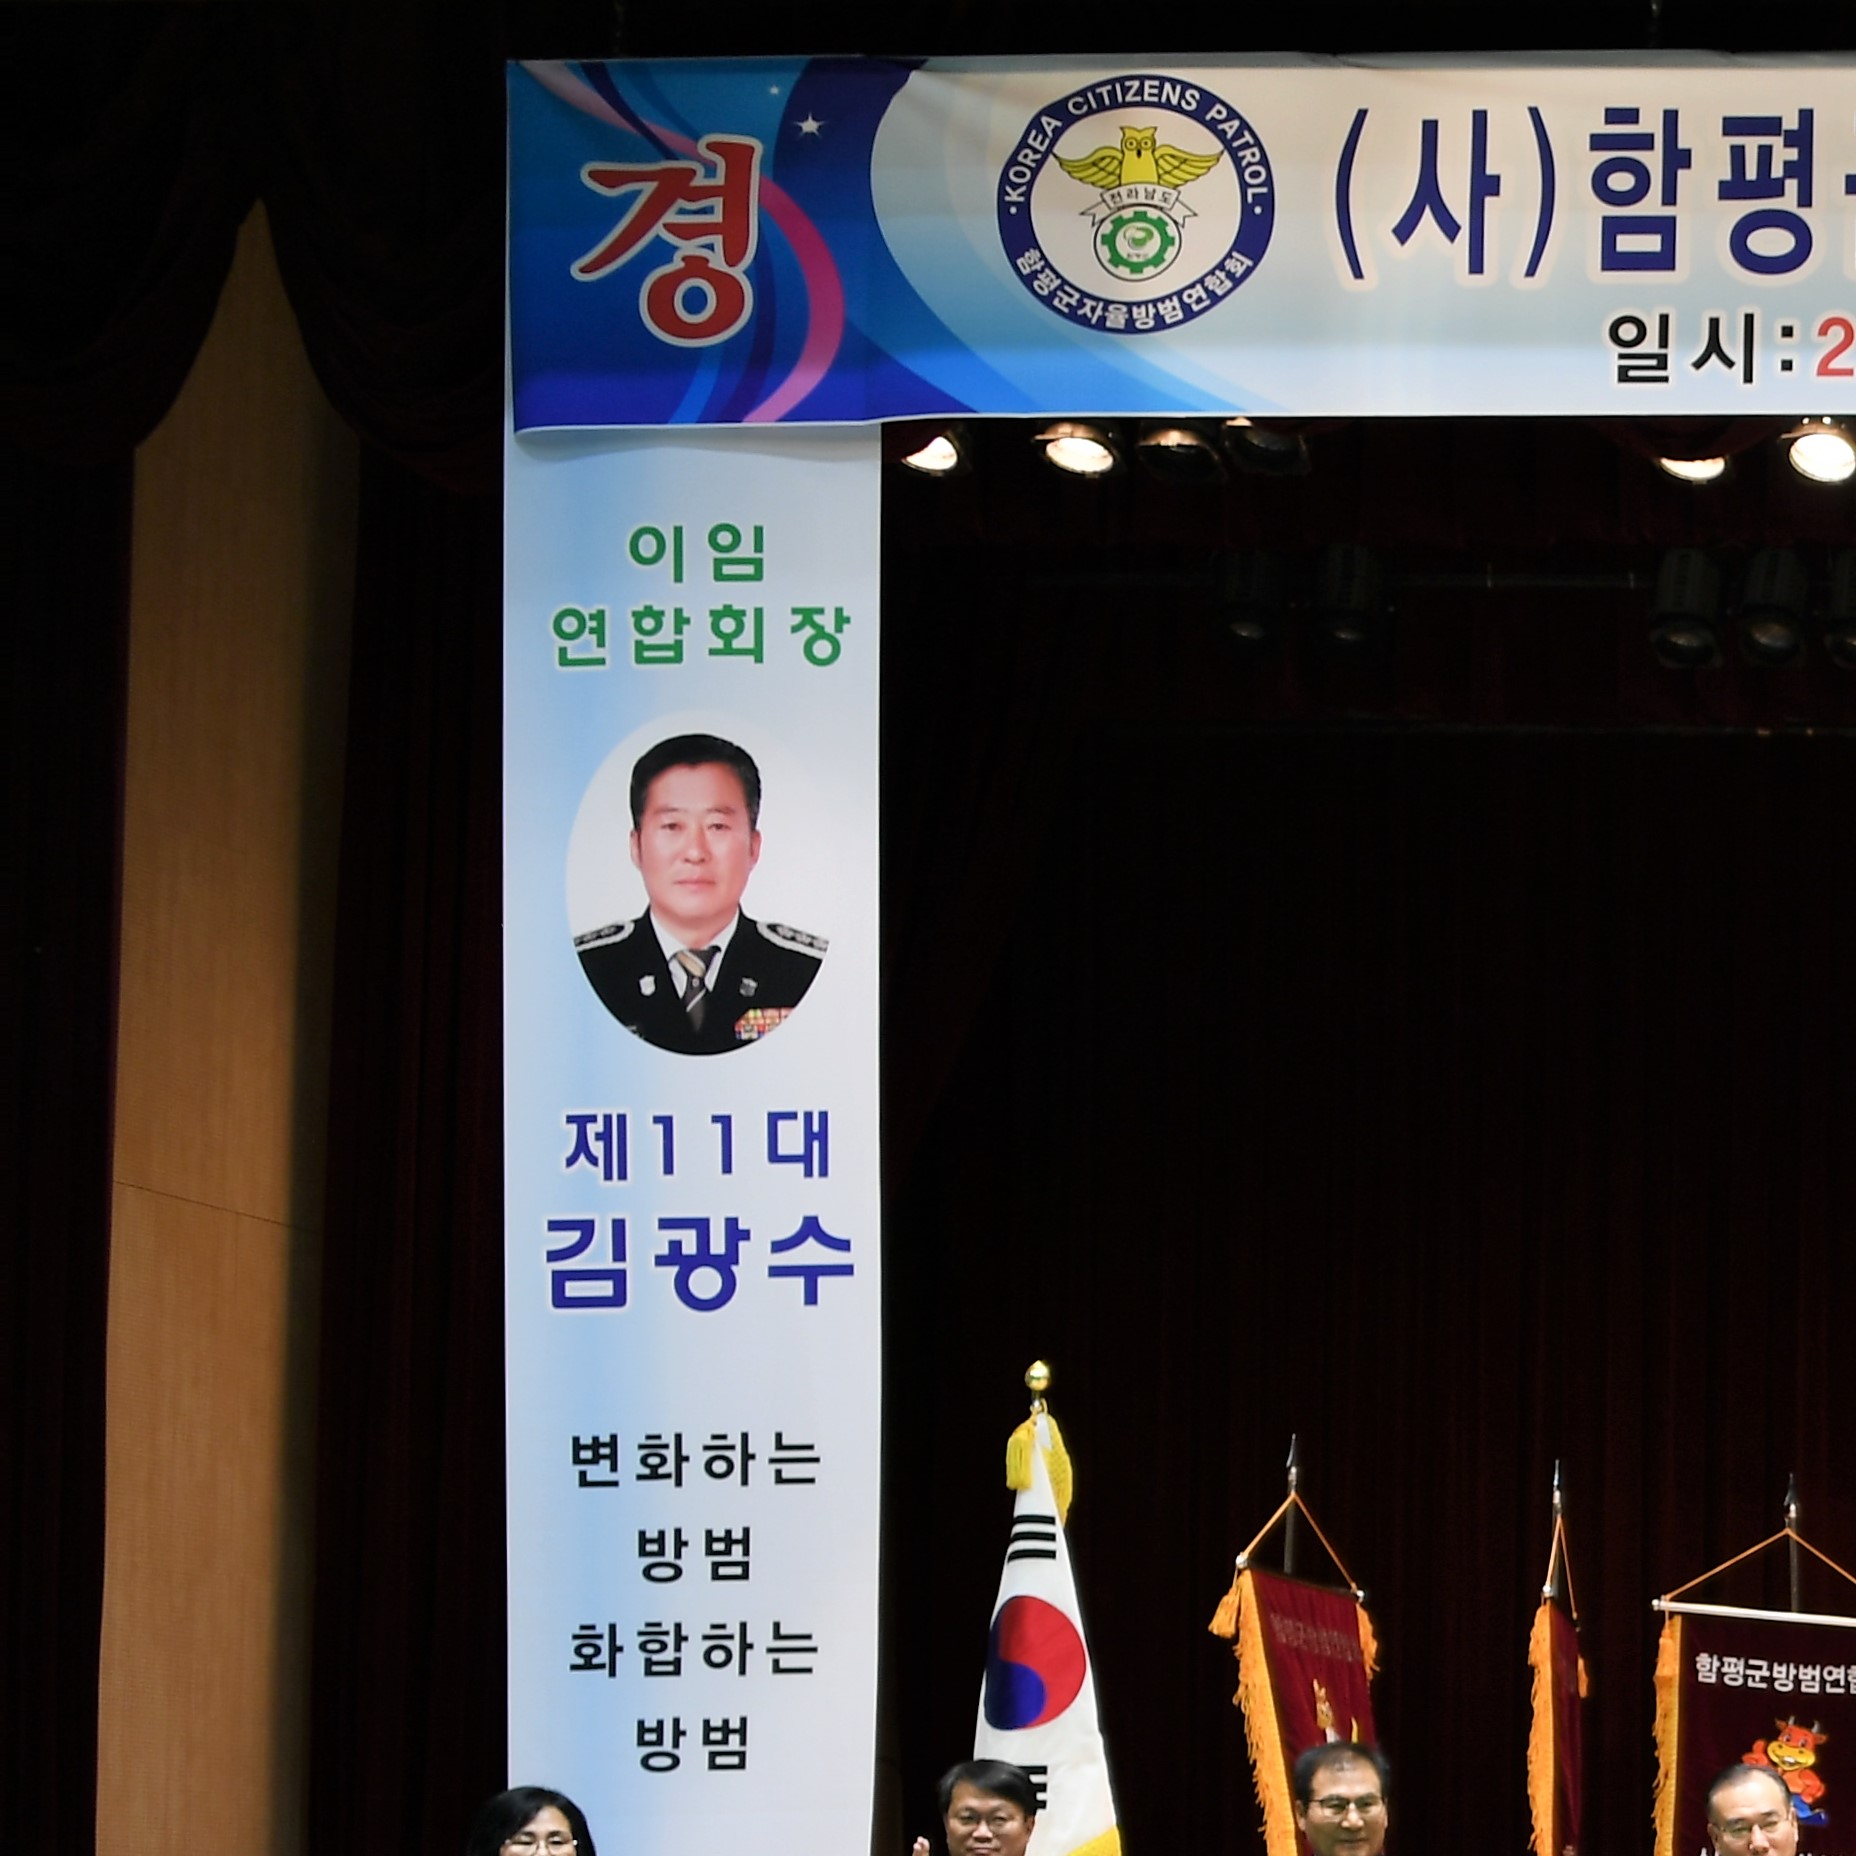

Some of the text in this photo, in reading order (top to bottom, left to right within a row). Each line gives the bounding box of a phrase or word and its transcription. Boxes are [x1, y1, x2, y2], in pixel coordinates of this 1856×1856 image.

[1004, 78, 1269, 203] KOREA CITIZENS PATROL
[577, 137, 756, 338] 경
[1015, 248, 1255, 330] 함평군자율방범연합회
[629, 523, 763, 583] 이임
[548, 595, 851, 667] 연합회장
[565, 1110, 828, 1181] 제11대
[546, 1215, 854, 1312] 김광수
[572, 1432, 820, 1489] 변화하는
[638, 1527, 750, 1584] 방범
[569, 1621, 818, 1679] 화합하는
[636, 1716, 747, 1773] 방범
